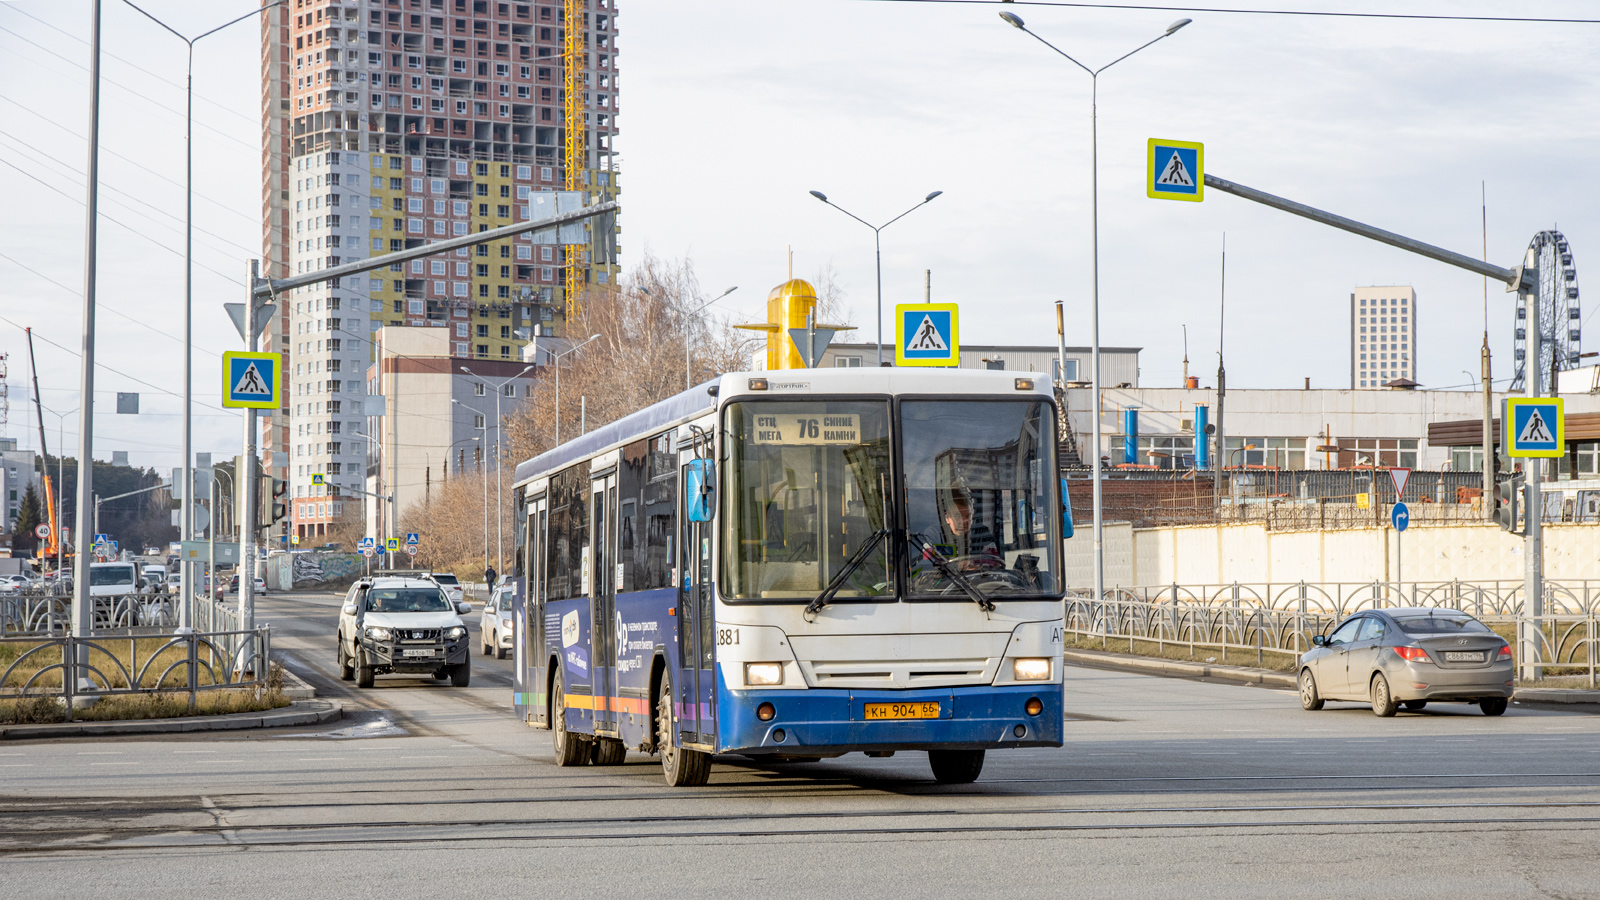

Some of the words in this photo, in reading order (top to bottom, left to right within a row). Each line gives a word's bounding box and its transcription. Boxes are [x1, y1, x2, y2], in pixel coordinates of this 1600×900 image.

[757, 416, 777, 428] СТЦ
[797, 418, 820, 438] 76
[823, 416, 853, 427] СИНИЕ
[758, 430, 782, 441] МЕГА
[823, 430, 856, 441] КАМНИ
[39, 527, 48, 535] 40
[871, 707, 887, 717] КН
[892, 704, 916, 717] 904
[922, 703, 935, 713] 66
